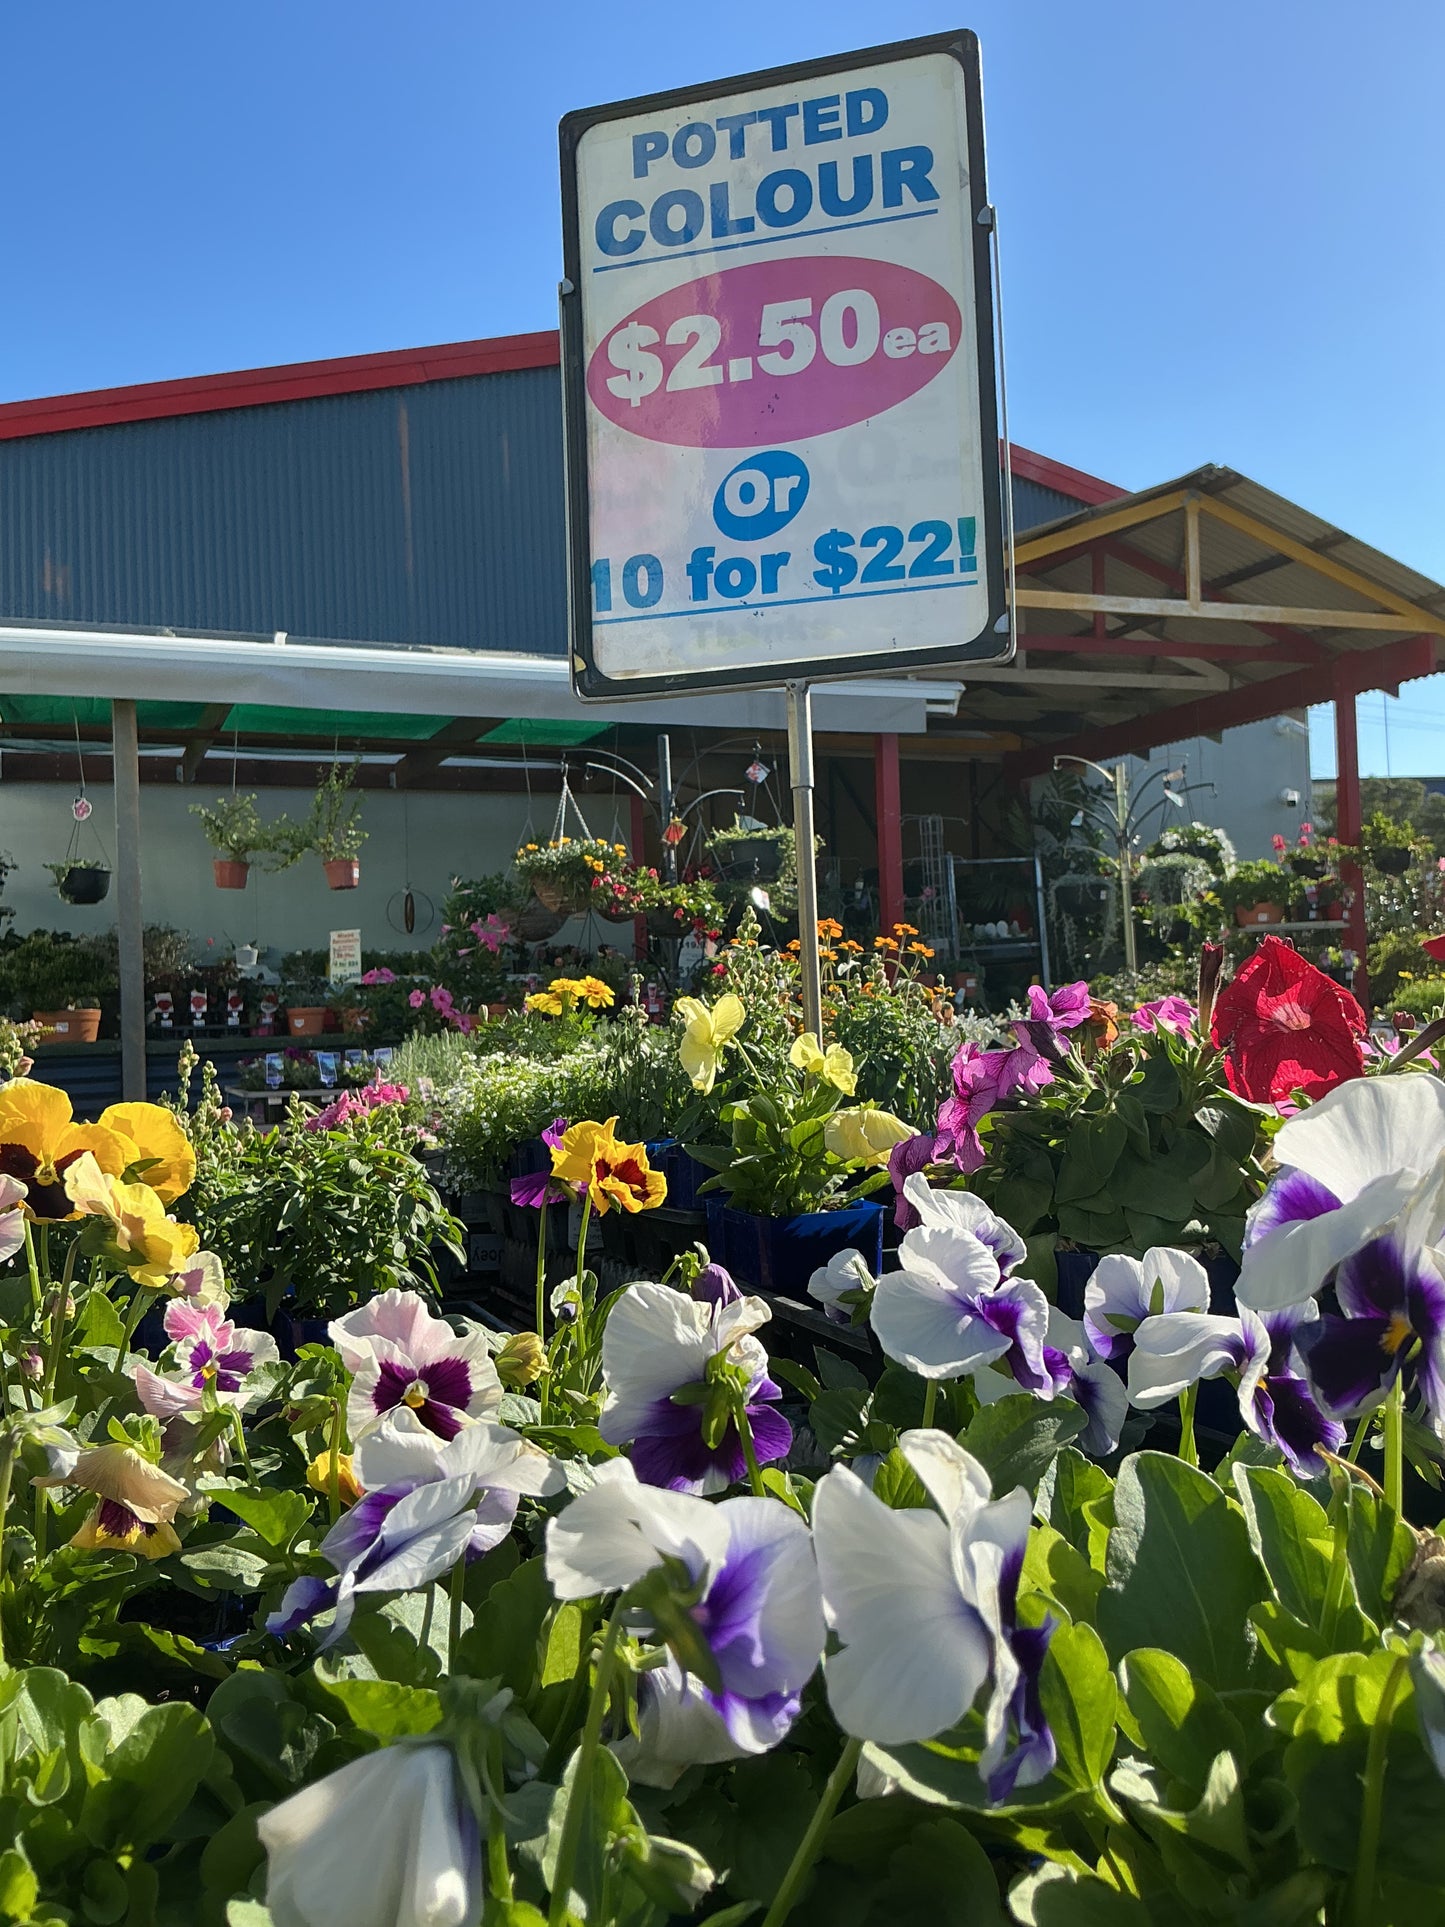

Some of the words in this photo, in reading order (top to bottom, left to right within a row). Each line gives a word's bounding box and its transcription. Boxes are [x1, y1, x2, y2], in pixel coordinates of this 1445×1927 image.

[632, 87, 889, 179] POTTED
[595, 145, 940, 256] COLOUR
[605, 288, 952, 407] $2.50ea
[724, 469, 800, 517] Or
[590, 553, 664, 613] 10
[686, 546, 791, 602] for
[812, 516, 978, 594] $22!
